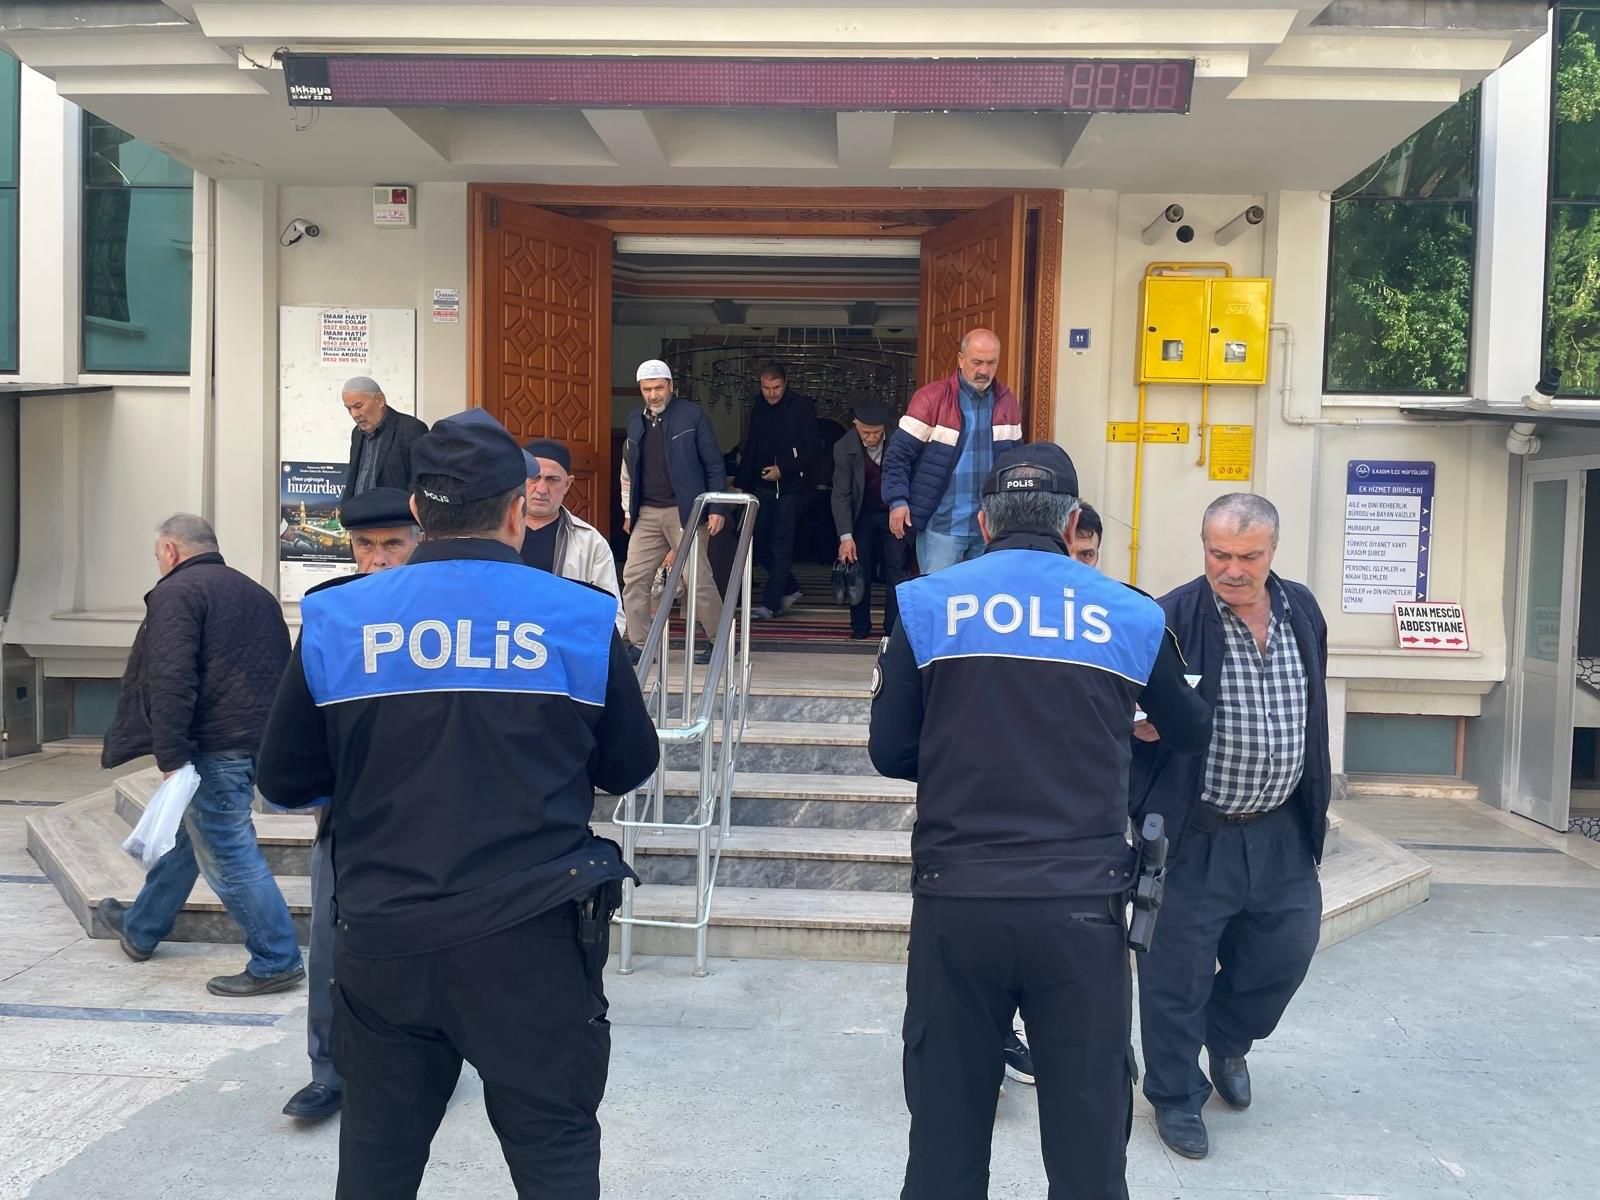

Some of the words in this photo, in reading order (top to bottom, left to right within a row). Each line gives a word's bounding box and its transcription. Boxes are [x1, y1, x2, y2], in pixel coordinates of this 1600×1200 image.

[290, 85, 332, 96] akkaya
[288, 478, 346, 498] huzurday
[946, 587, 1112, 644] POLİS
[1398, 606, 1428, 617] BAYAN
[1429, 606, 1460, 618] MESCİD
[1400, 620, 1464, 632] ABDESTHANE
